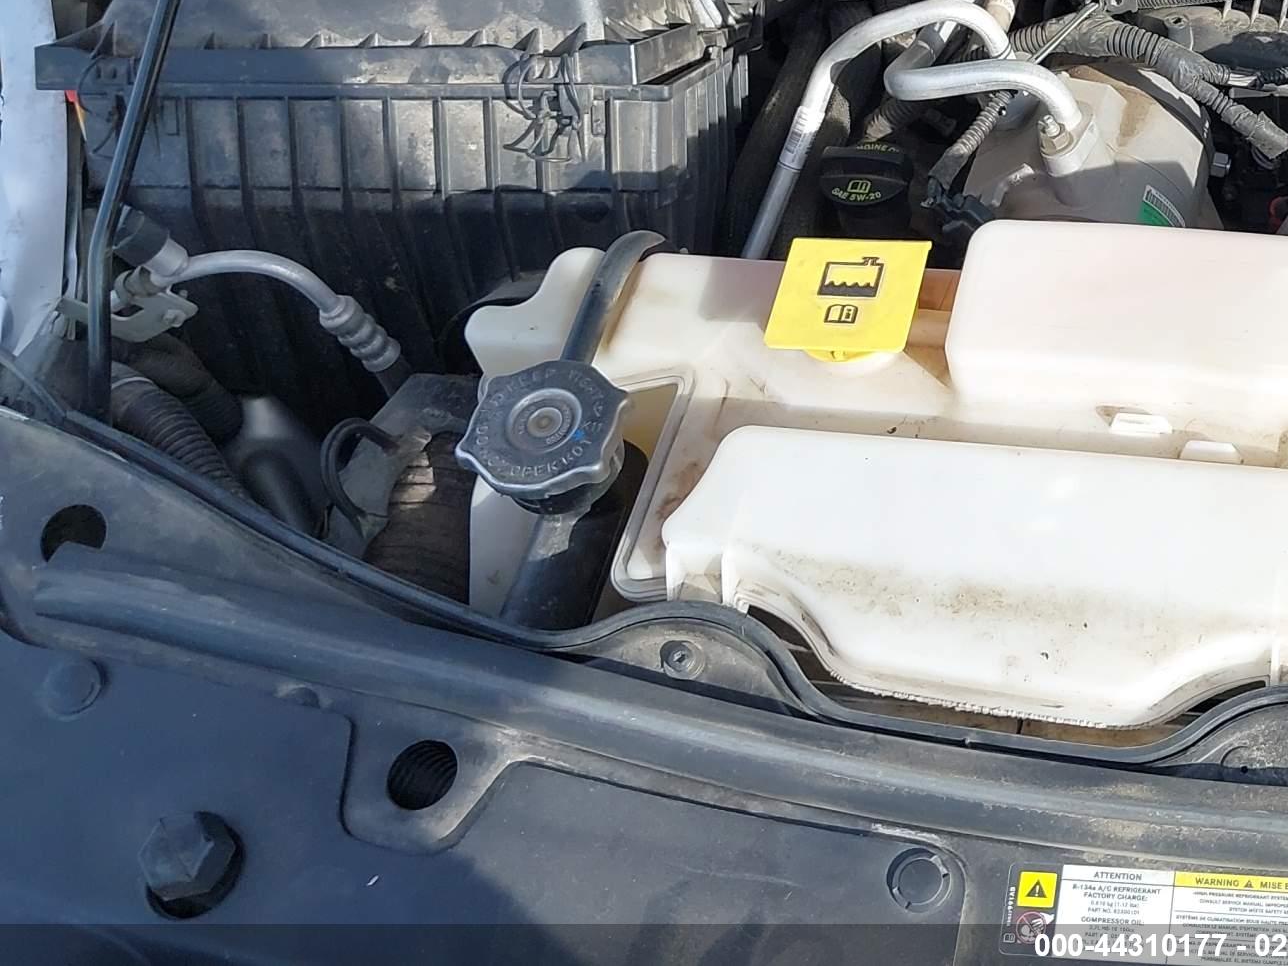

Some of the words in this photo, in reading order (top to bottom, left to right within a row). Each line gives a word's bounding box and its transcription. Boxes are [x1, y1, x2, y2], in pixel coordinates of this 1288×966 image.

[831, 187, 849, 199] SAE
[849, 191, 882, 201] 5W-20
[1093, 871, 1143, 881] ATTENTION
[1195, 877, 1240, 888] WARNING
[1259, 881, 1282, 890] MISE
[1113, 886, 1162, 895] REFRIGERANT
[1083, 891, 1116, 900] FACTORY
[1080, 916, 1129, 925] COMPRESSOR
